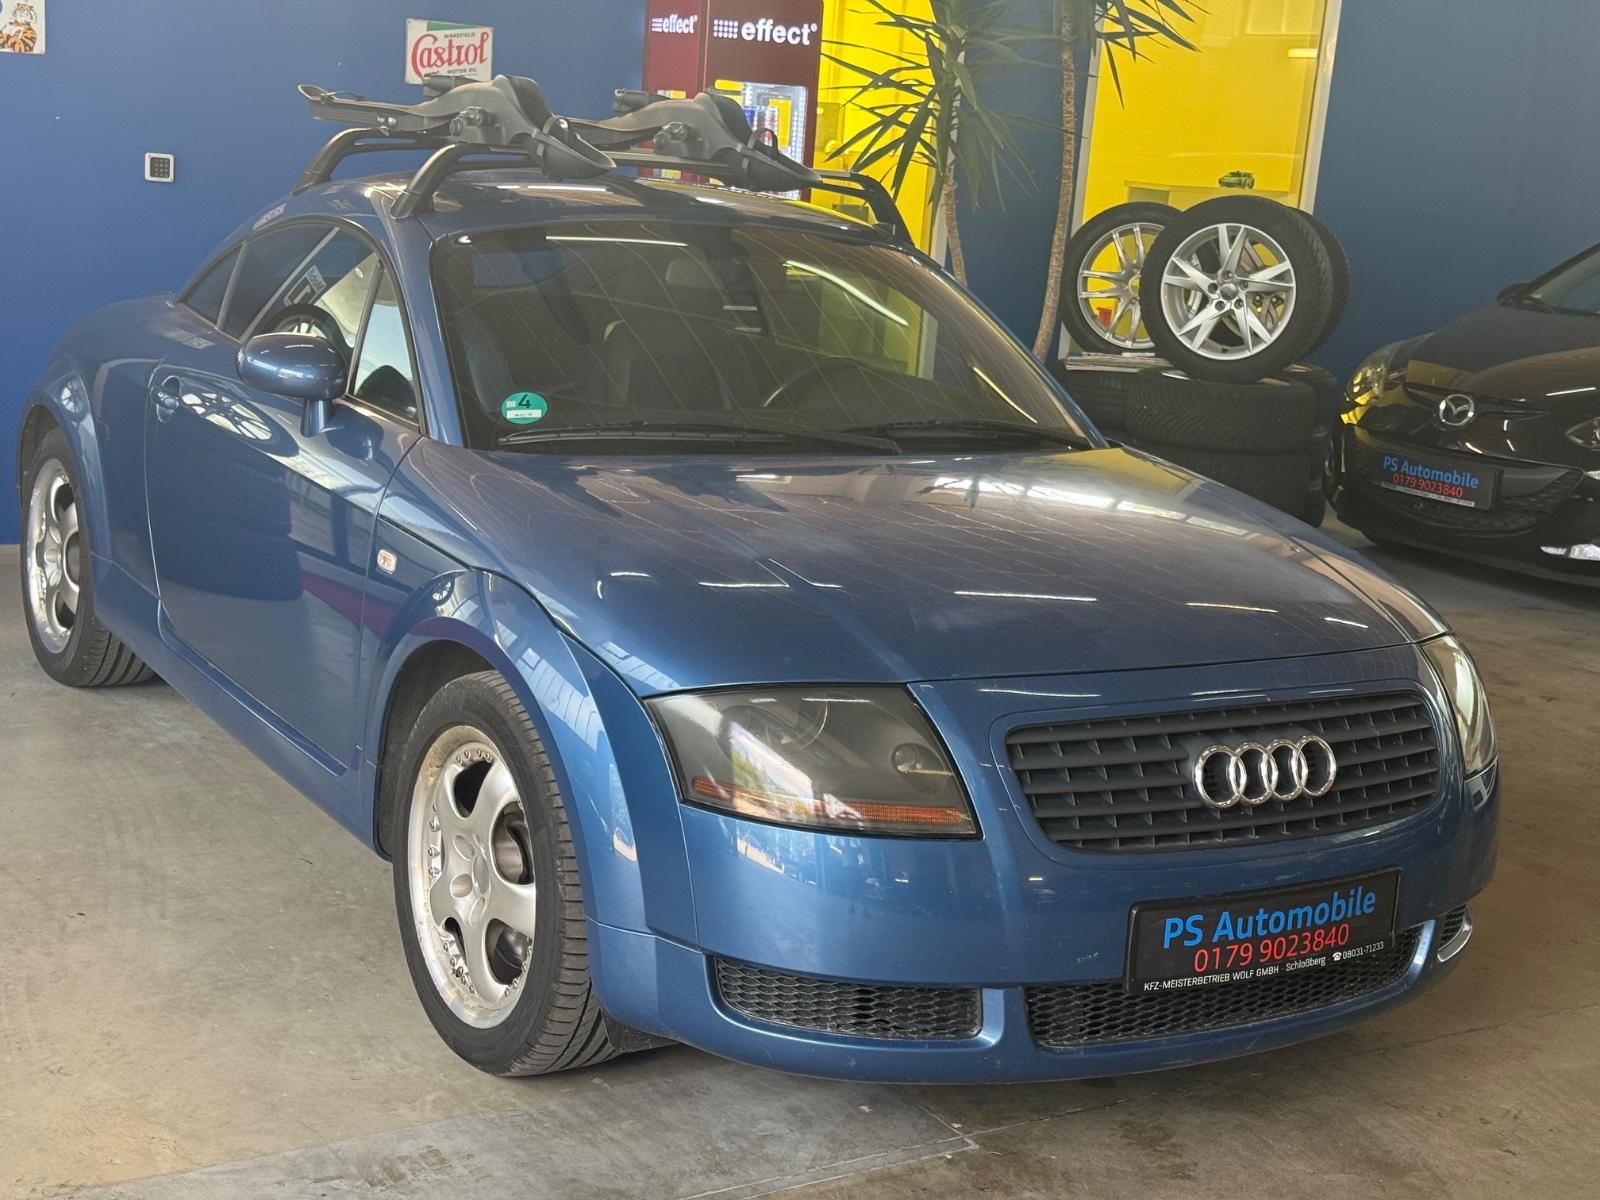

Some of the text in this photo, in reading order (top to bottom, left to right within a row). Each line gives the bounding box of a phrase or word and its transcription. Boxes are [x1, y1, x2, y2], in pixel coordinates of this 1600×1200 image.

[411, 31, 489, 80] Castrol
[518, 393, 532, 409] 4
[1383, 455, 1479, 489] PS Automobile
[1392, 472, 1417, 487] 0179
[1418, 479, 1463, 498] 9023840
[1163, 885, 1376, 949] PS Automobile
[1144, 940, 1384, 991] KFZ-MEISTERBETRIEB WOLF GMBH Schloßberg 08031-71233
[1194, 923, 1349, 973] 0179 9023840
